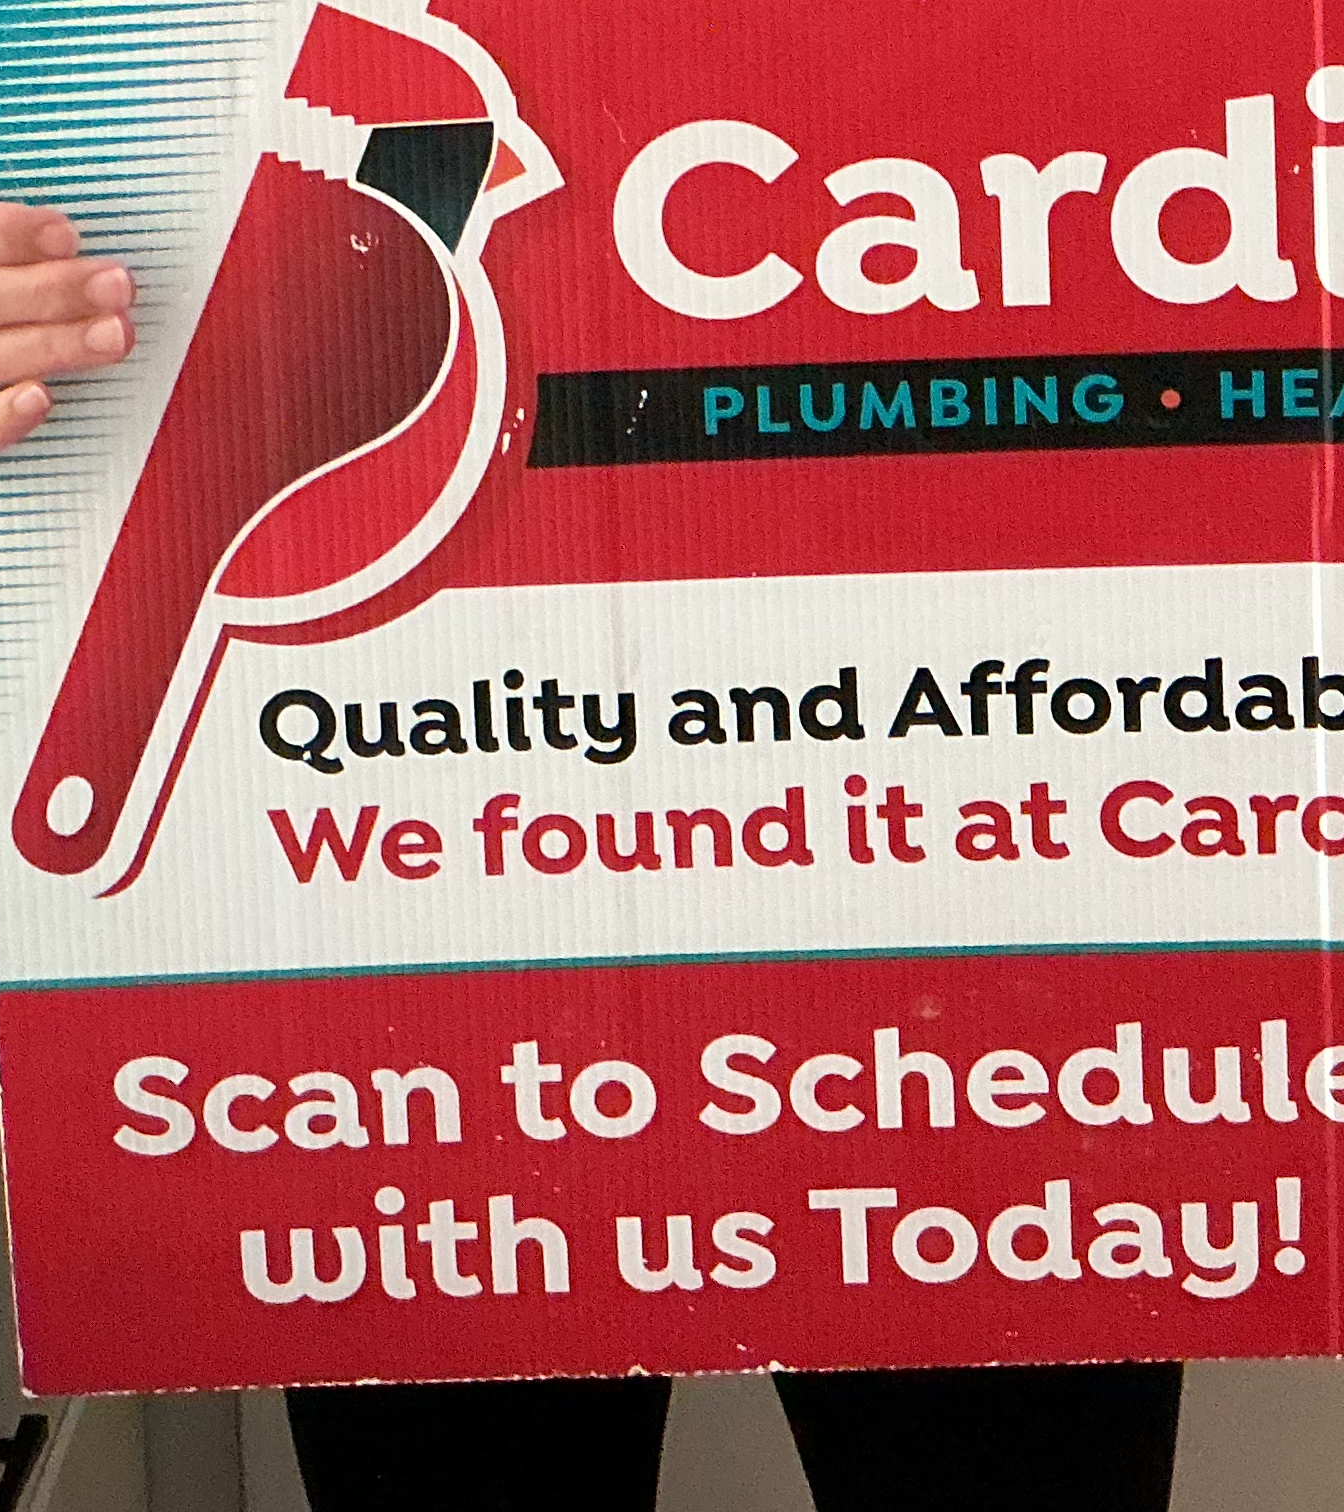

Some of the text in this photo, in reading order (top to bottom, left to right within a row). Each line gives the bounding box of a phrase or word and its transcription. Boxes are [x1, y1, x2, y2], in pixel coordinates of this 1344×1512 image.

[703, 373, 1125, 436] PLUMBING
[259, 669, 637, 774] Quality
[668, 666, 866, 746] and
[267, 805, 444, 885] We
[472, 786, 815, 877] found
[843, 773, 927, 865] it
[954, 782, 1071, 863] at
[113, 1055, 463, 1156] Scan
[500, 1039, 657, 1141] to
[240, 1176, 1306, 1305] with us Today!
